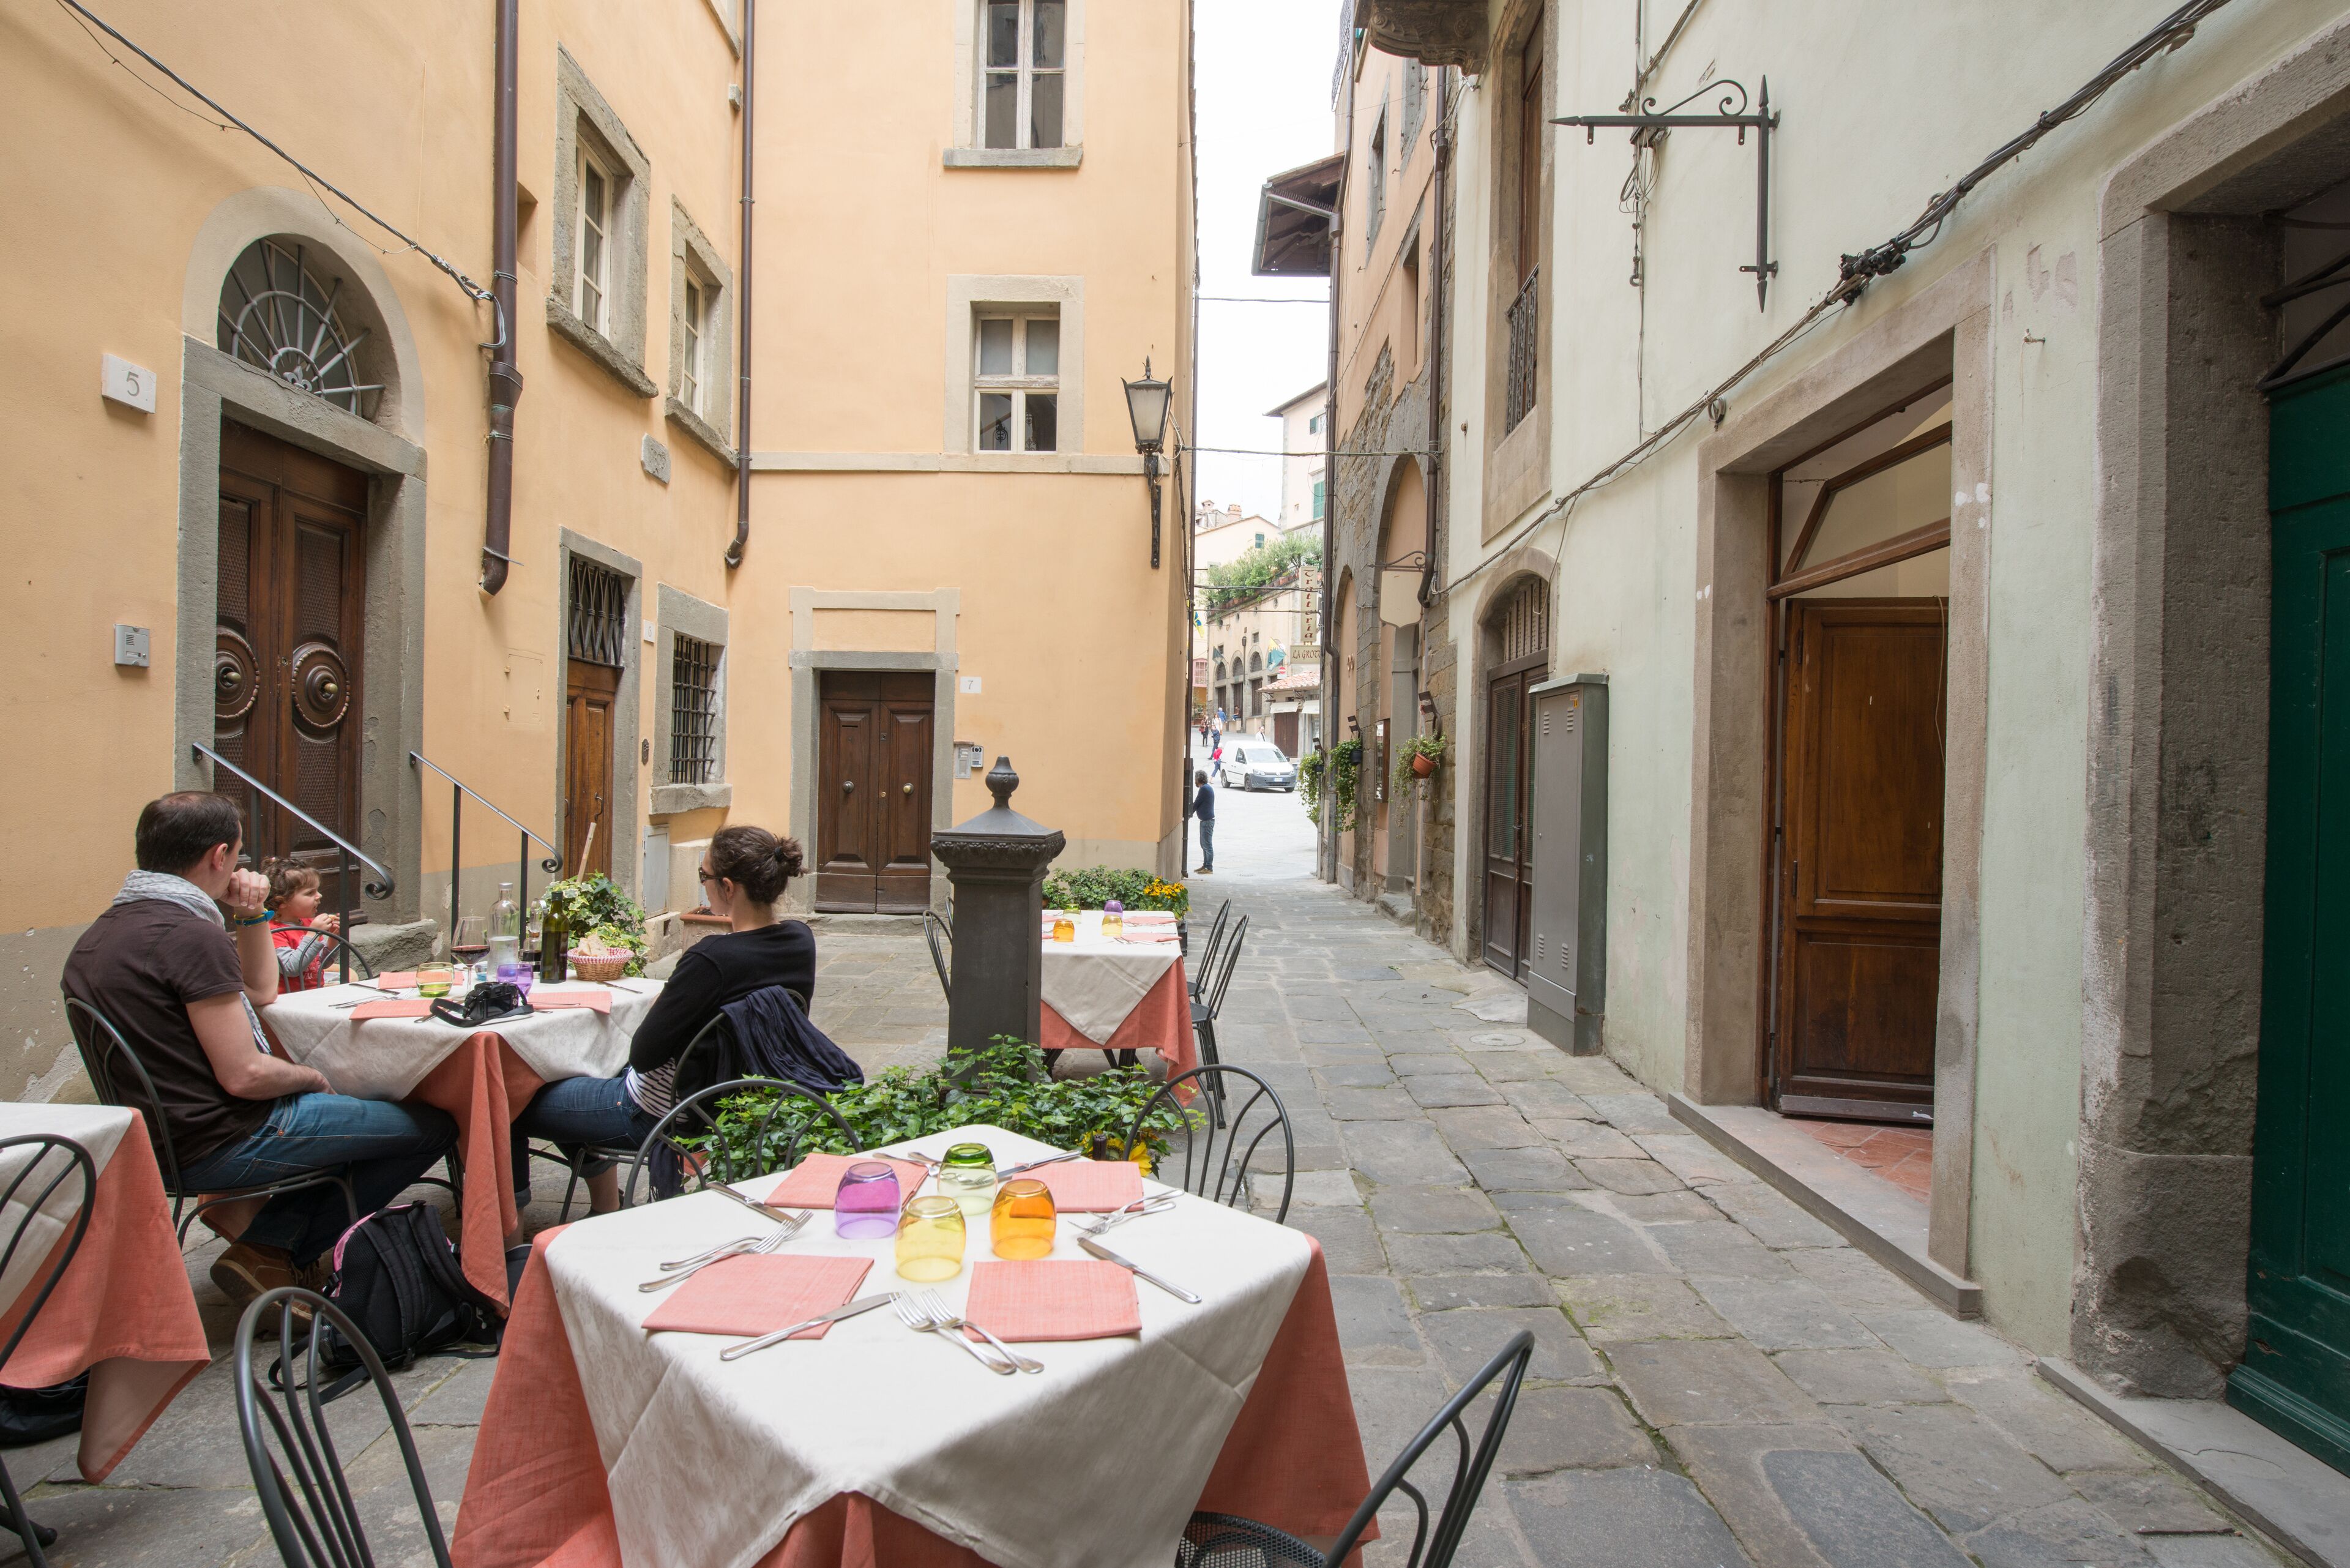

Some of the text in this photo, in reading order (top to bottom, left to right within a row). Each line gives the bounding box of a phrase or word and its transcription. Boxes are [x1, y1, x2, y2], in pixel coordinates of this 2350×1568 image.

[127, 371, 140, 397] 5
[648, 626, 652, 637] 6
[1292, 650, 1300, 659] LA
[967, 680, 974, 690] 7
